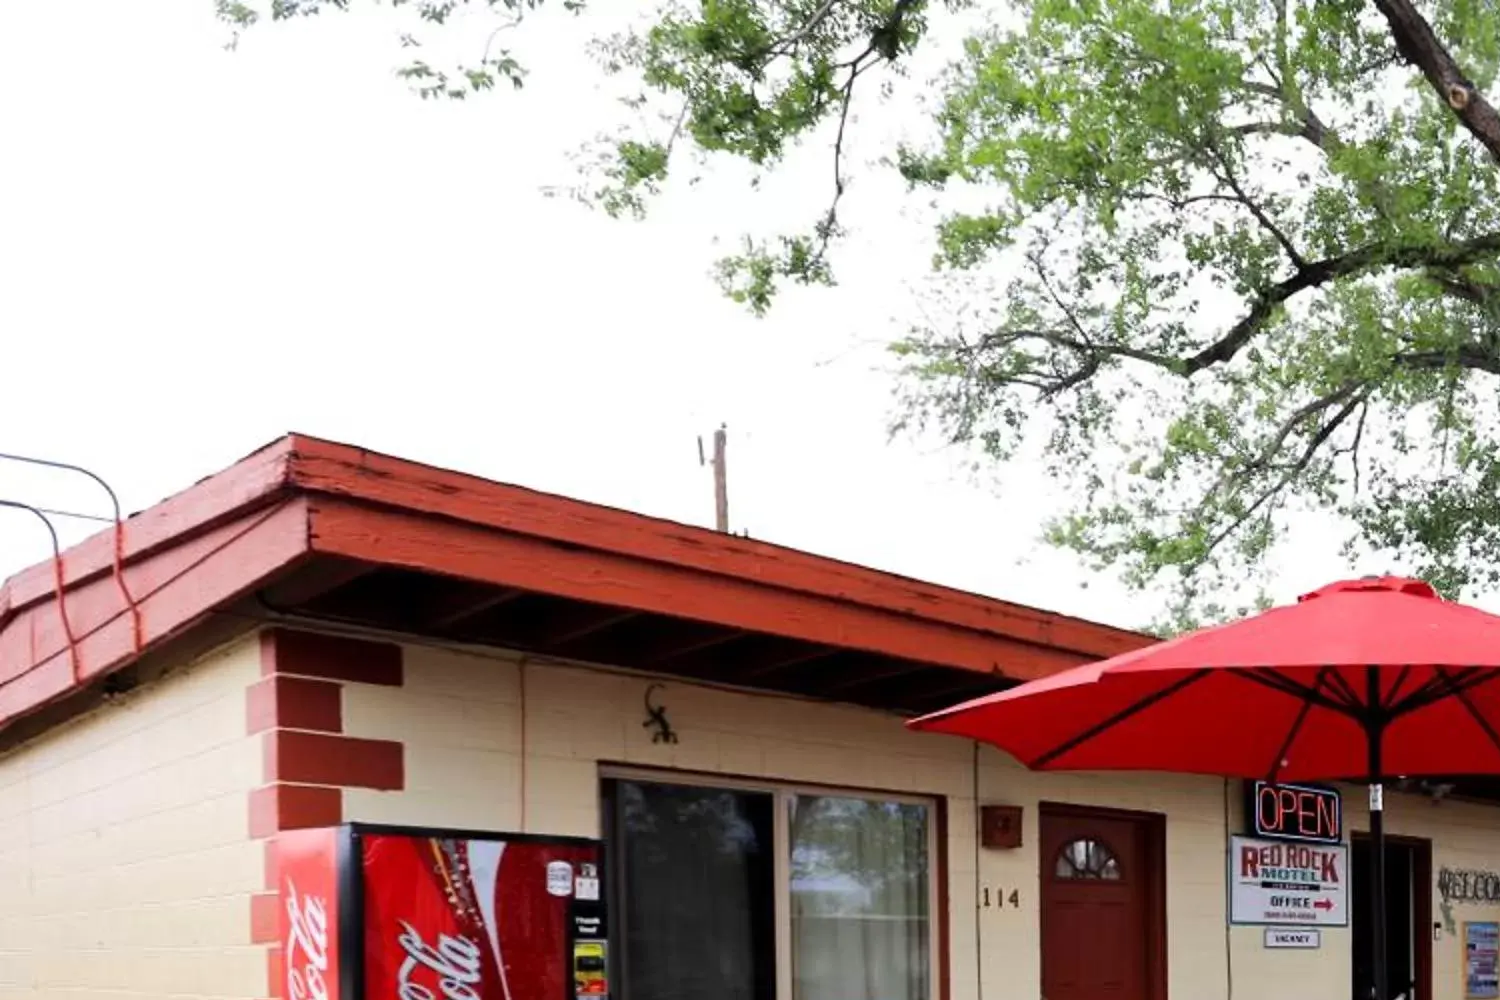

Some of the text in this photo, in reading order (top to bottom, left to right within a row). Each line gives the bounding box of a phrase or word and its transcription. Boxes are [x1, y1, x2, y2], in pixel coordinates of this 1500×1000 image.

[1259, 787, 1337, 837] OPEN
[1240, 844, 1339, 883] RED ROCK
[1261, 868, 1319, 882] MOTEL
[983, 887, 1019, 908] 114
[1270, 895, 1311, 909] OFFICE
[1274, 931, 1311, 943] VACANCY
